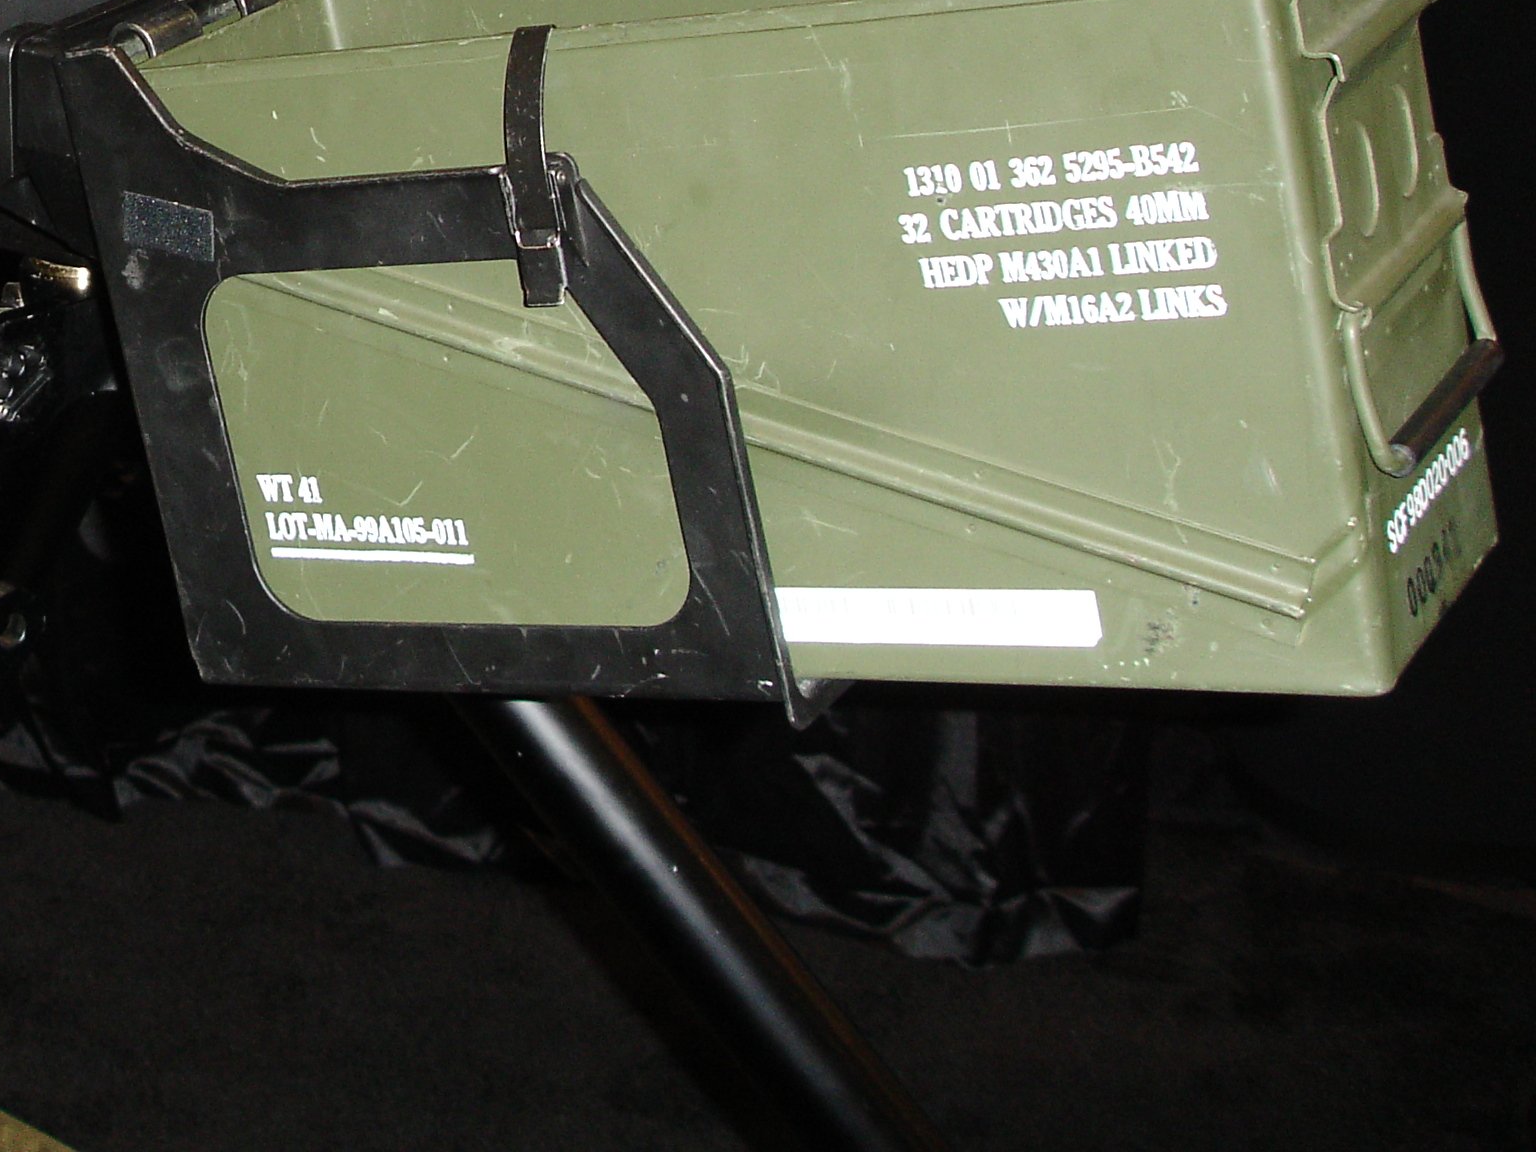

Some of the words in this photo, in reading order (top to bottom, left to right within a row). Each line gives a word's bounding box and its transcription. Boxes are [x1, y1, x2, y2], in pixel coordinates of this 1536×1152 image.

[903, 163, 963, 197] 1310
[969, 160, 1002, 192] 01
[1008, 155, 1057, 188] 362
[1062, 141, 1200, 184] 5295-B542
[898, 212, 932, 244] 32
[939, 195, 1119, 241] CARTRIDGES
[1125, 189, 1210, 226] 40MM
[918, 253, 994, 289] HEDP
[997, 246, 1105, 284] M430A1
[1107, 236, 1218, 275] LINKED
[998, 291, 1137, 329] W/M16A2
[1137, 284, 1228, 321] LINKS
[256, 474, 294, 503] WT
[298, 476, 323, 504] 41
